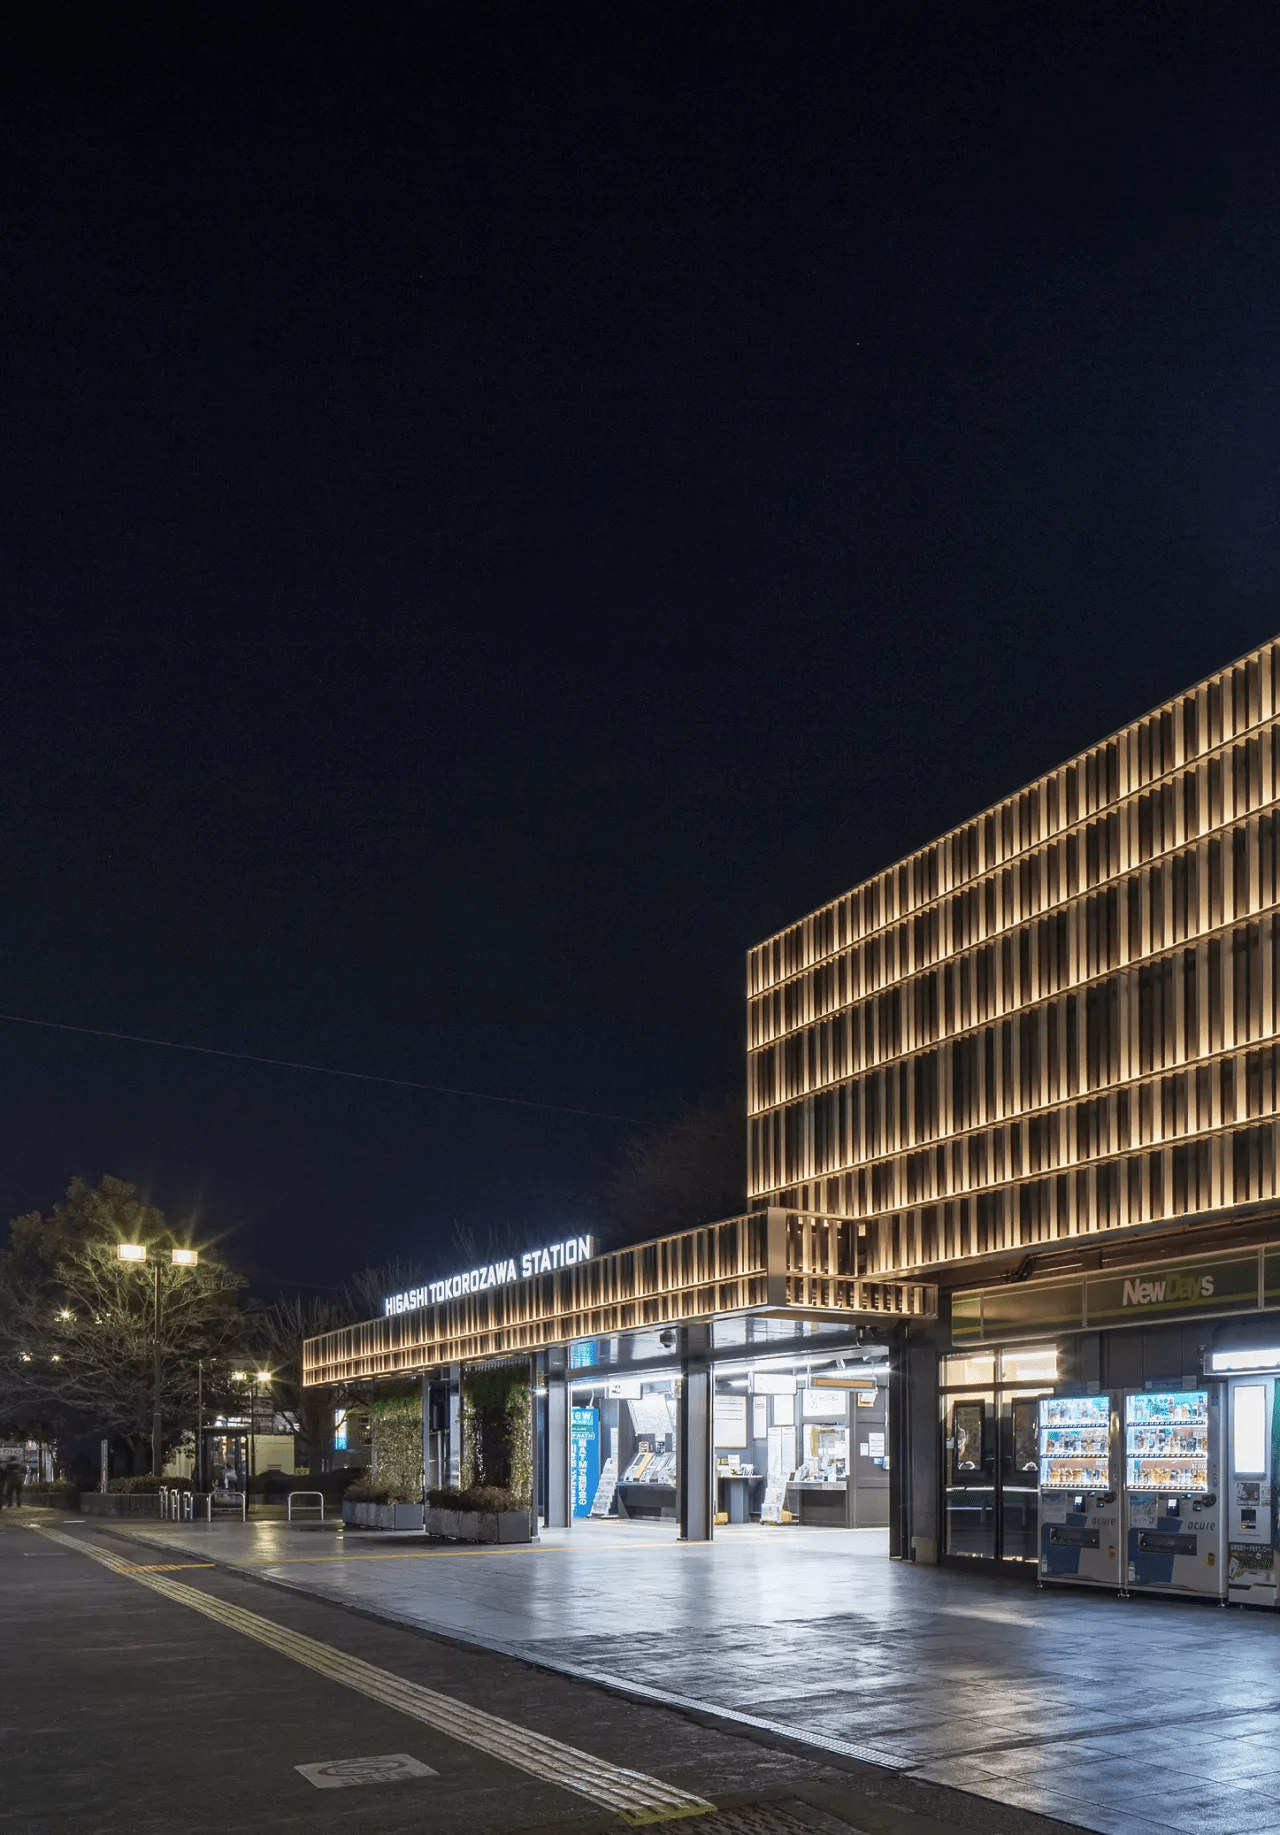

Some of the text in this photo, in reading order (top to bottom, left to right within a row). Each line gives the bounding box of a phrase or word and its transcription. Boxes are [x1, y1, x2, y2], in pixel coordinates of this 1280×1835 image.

[385, 1235, 592, 1316] HIGASHI TOKOROZAWA STATION
[1122, 1273, 1214, 1306] NewDays
[1091, 1517, 1116, 1526] acure
[1187, 1521, 1216, 1532] acure
